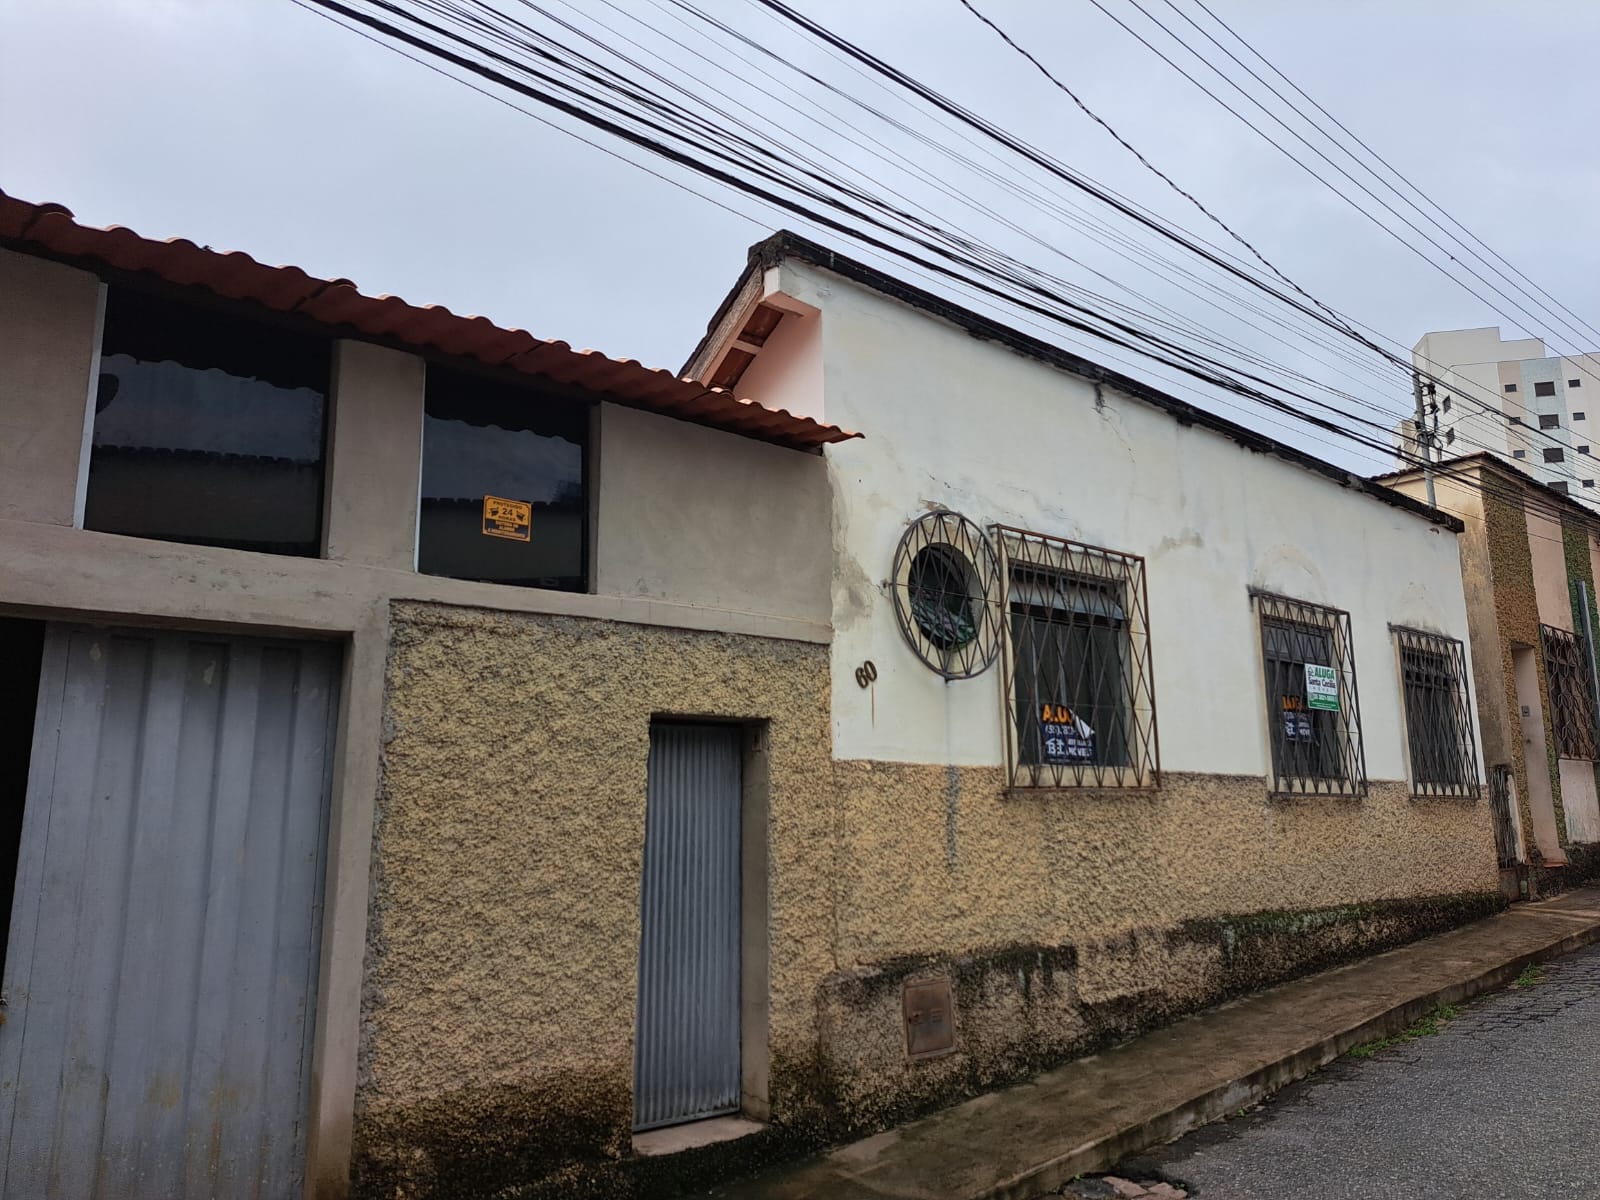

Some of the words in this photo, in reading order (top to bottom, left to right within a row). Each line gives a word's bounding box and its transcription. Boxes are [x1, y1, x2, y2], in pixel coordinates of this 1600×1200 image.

[502, 508, 513, 516] 24
[855, 660, 878, 689] 60
[1314, 667, 1335, 680] ALUGA
